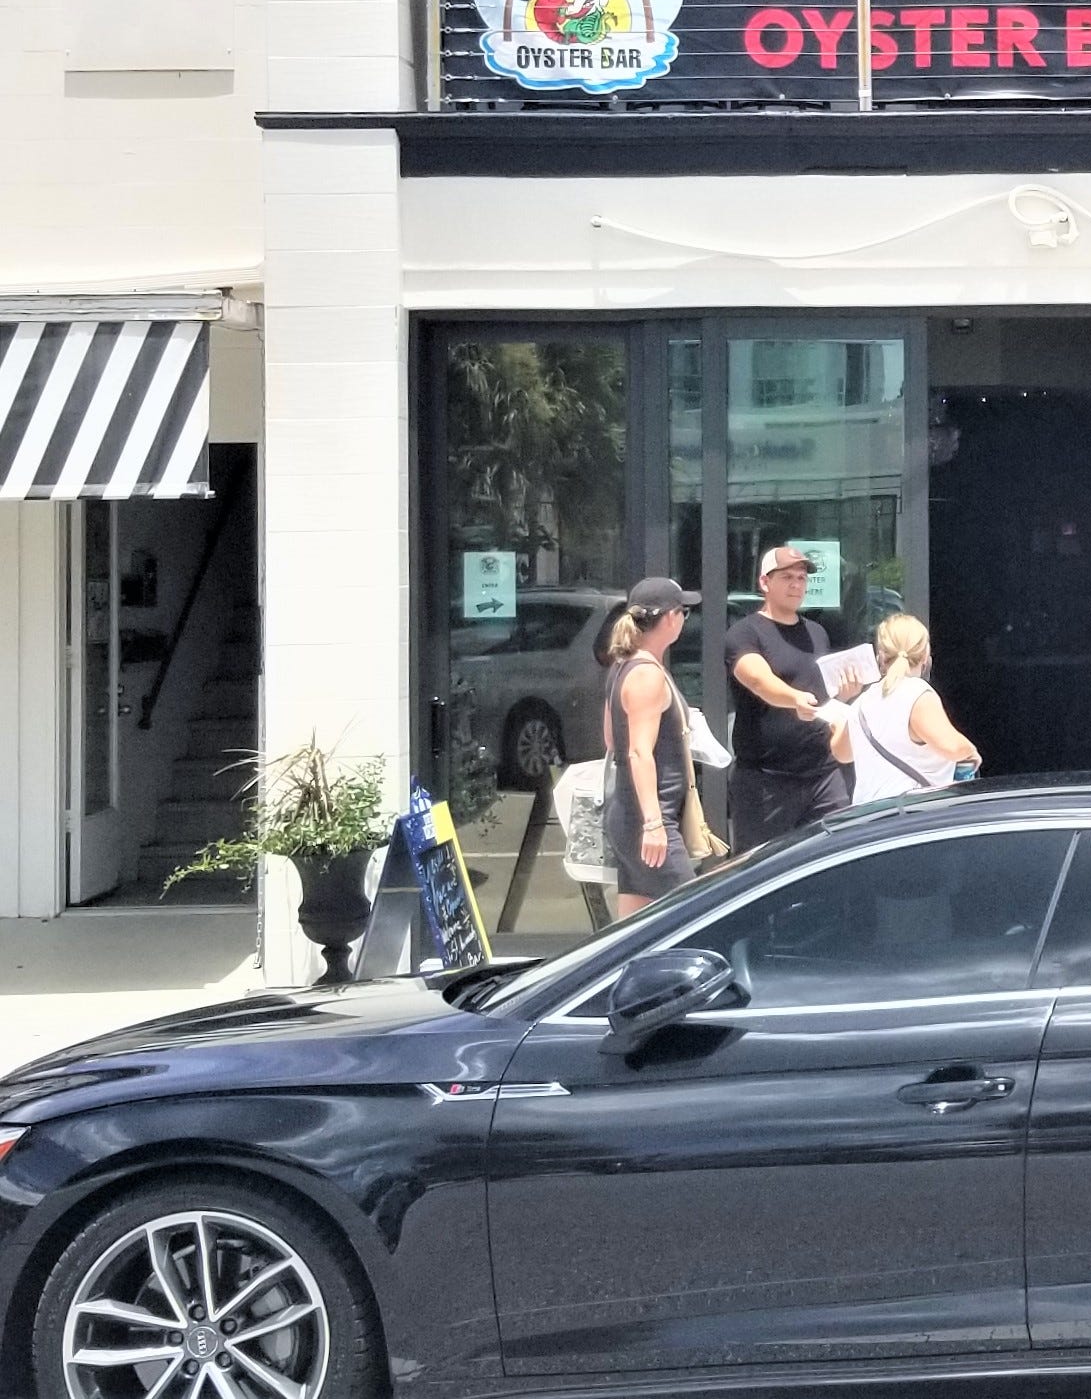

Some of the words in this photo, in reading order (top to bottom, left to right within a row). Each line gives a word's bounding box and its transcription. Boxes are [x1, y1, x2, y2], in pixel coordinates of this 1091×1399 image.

[516, 45, 593, 70] OYSTER
[601, 46, 642, 70] BAR
[743, 7, 1049, 70] OYSTER
